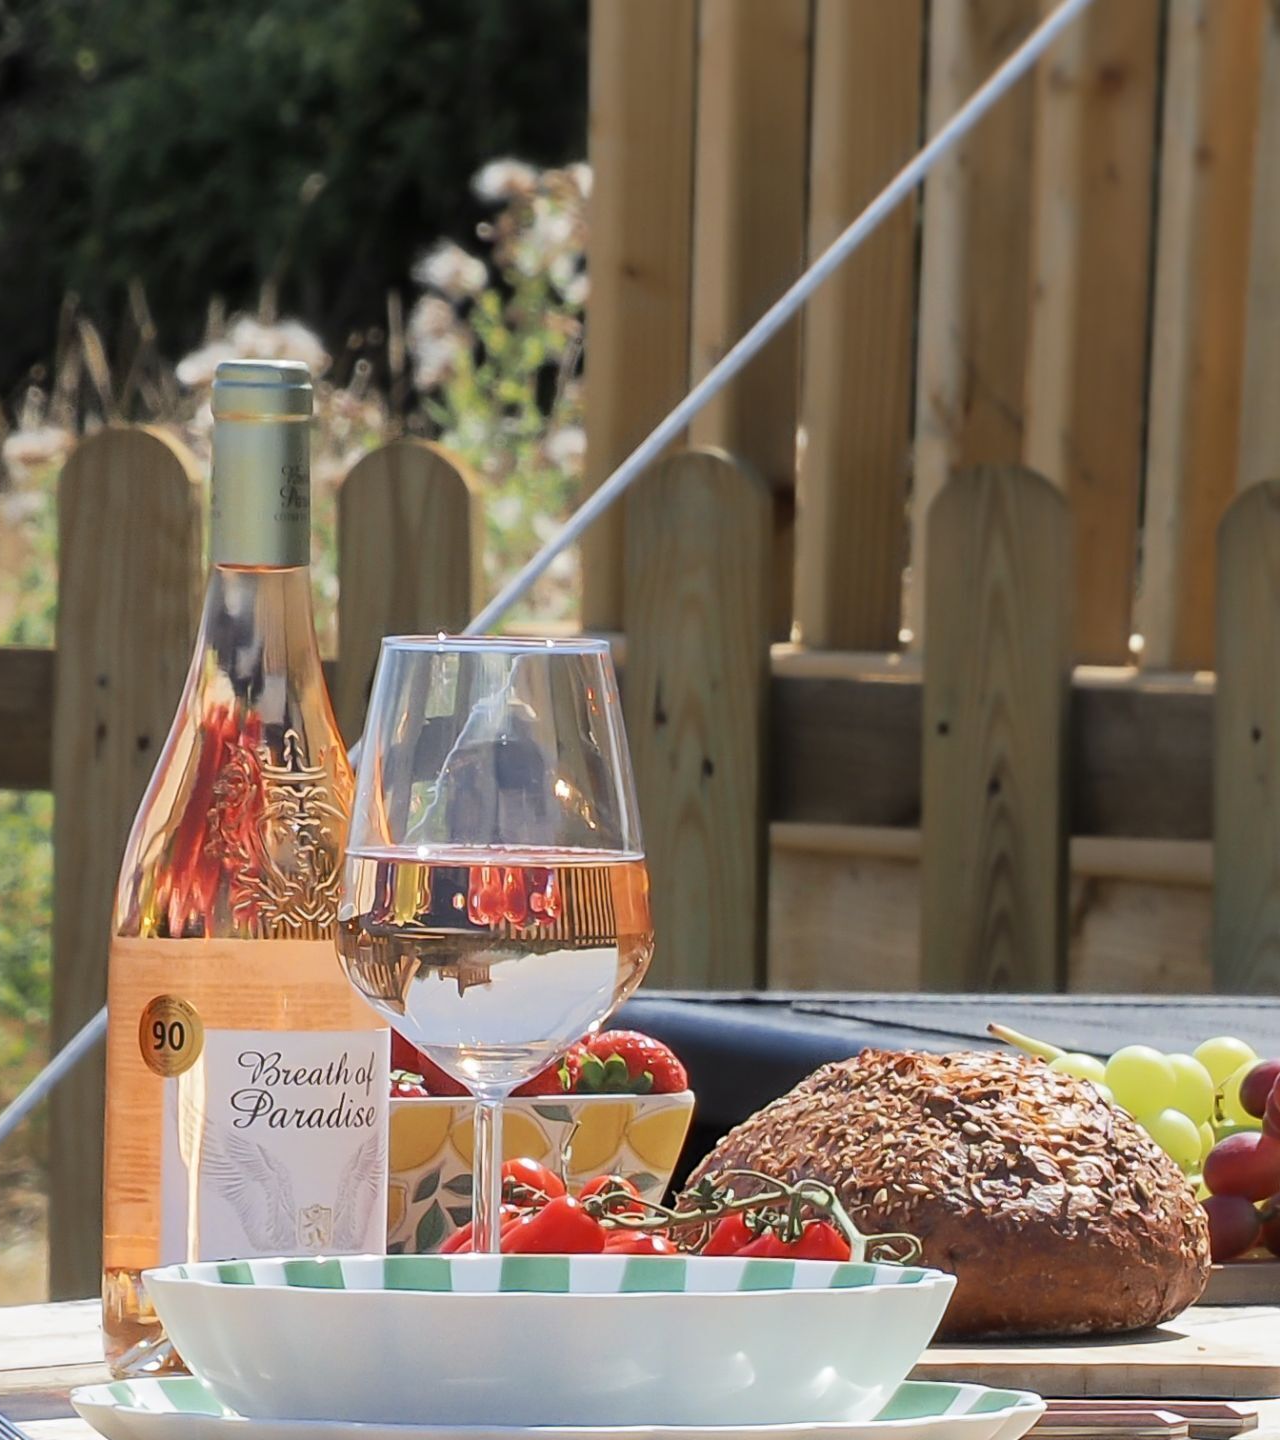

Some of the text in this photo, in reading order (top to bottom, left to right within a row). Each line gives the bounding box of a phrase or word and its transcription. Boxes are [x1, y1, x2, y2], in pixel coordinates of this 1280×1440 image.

[153, 1020, 185, 1051] 90
[238, 1050, 375, 1097] Breath of
[231, 1088, 376, 1129] Paradise
